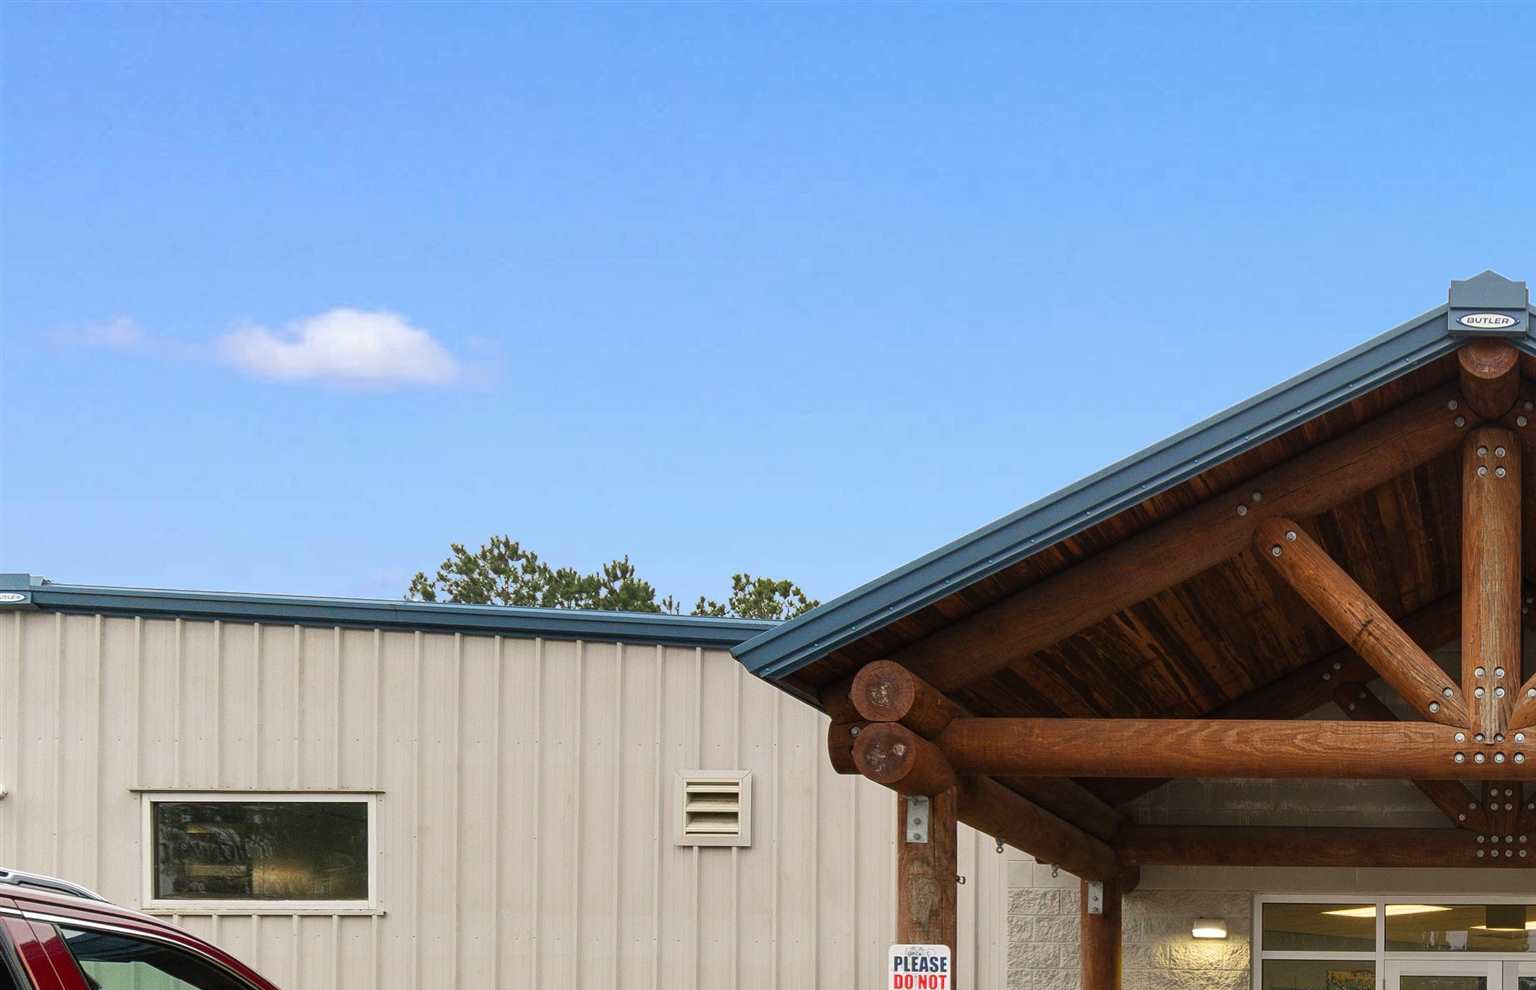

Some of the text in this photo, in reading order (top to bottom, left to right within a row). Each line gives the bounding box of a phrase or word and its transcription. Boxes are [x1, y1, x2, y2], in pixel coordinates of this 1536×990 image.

[893, 956, 948, 972] PLEASE
[893, 974, 947, 990] DO NOT
